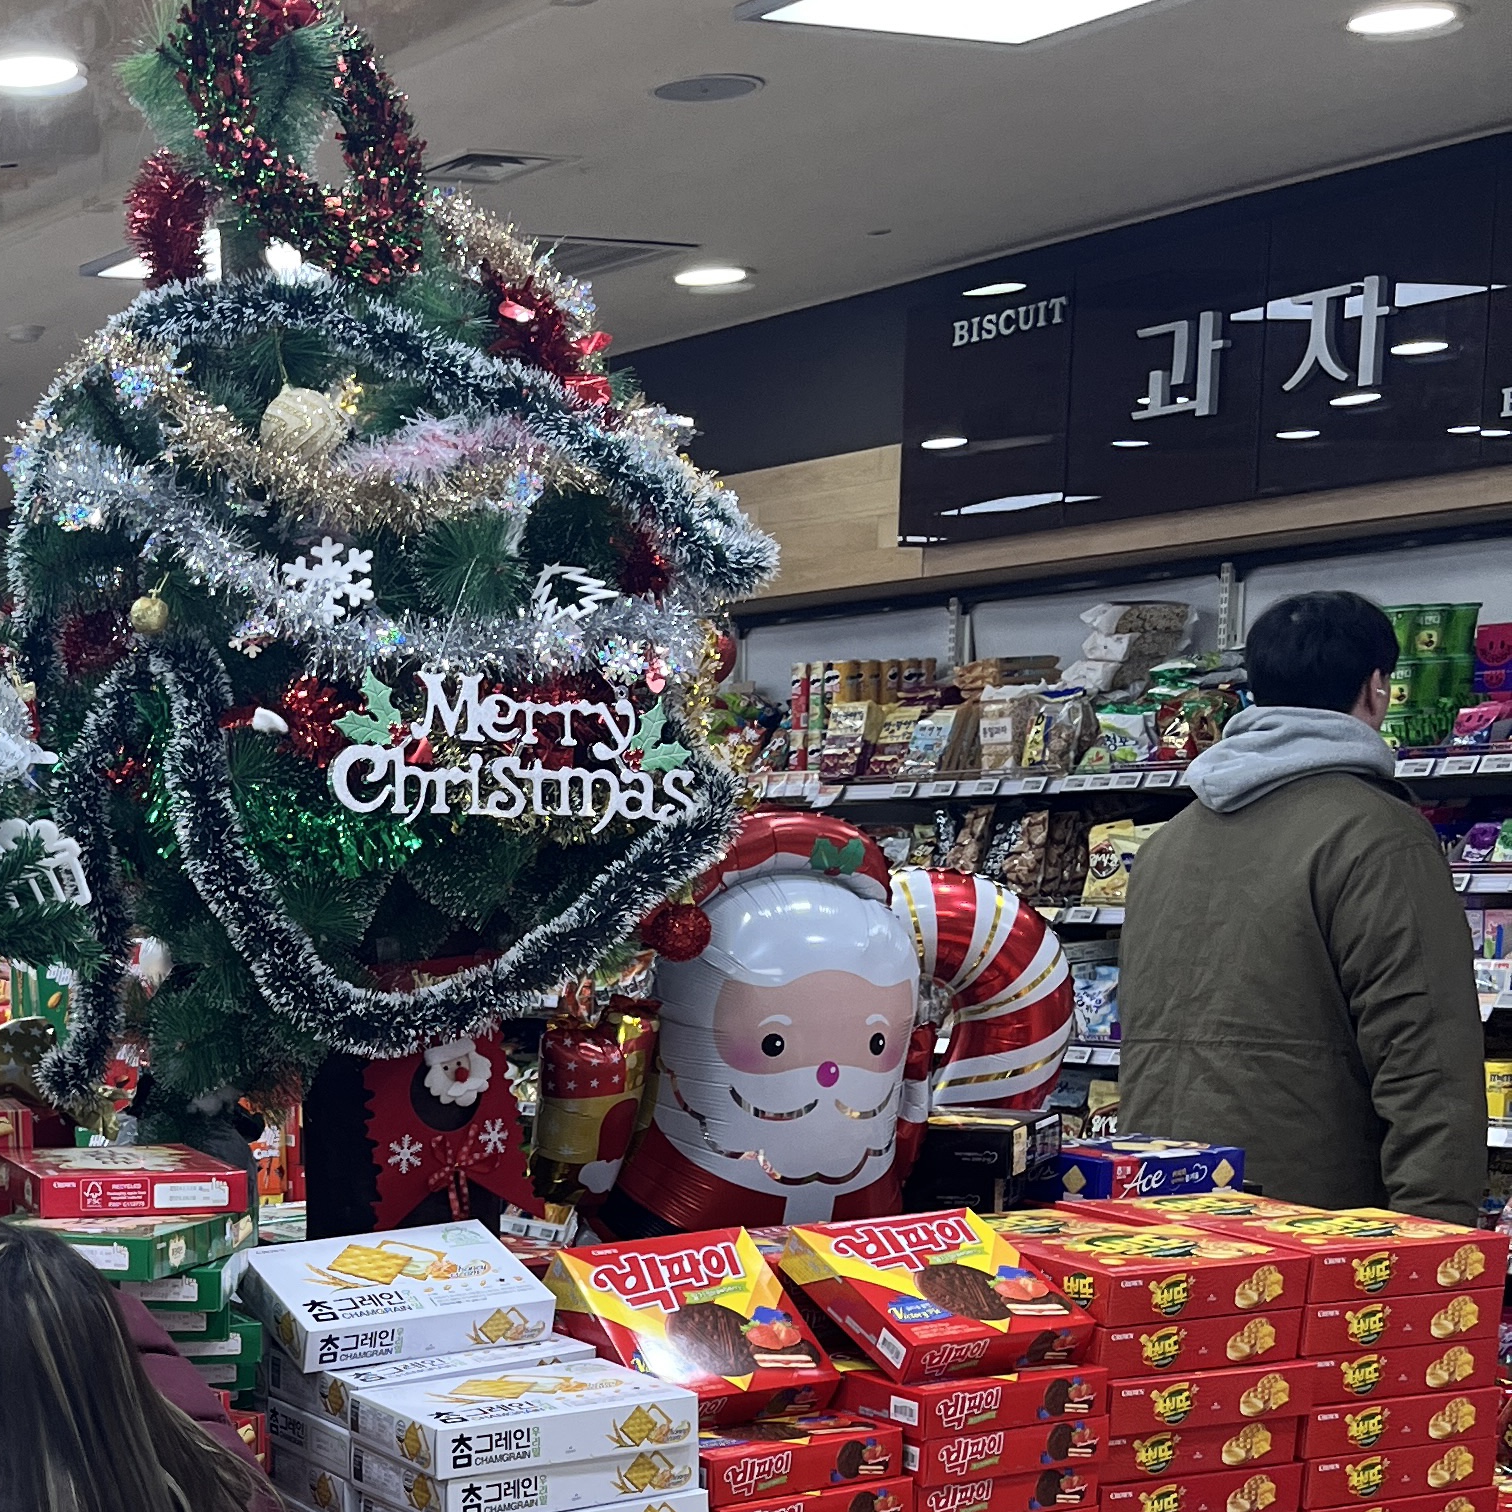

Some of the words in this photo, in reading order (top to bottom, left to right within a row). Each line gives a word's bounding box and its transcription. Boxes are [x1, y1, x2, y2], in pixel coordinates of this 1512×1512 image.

[953, 297, 1068, 347] BISCUIT
[411, 669, 636, 760] Merry
[331, 743, 697, 835] Christmas
[1121, 1161, 1168, 1198] Ace
[831, 1216, 981, 1273] 빅파이
[591, 1241, 746, 1314] 빅파이
[921, 1339, 991, 1376] 빅파이
[724, 1451, 793, 1497] 빅파이
